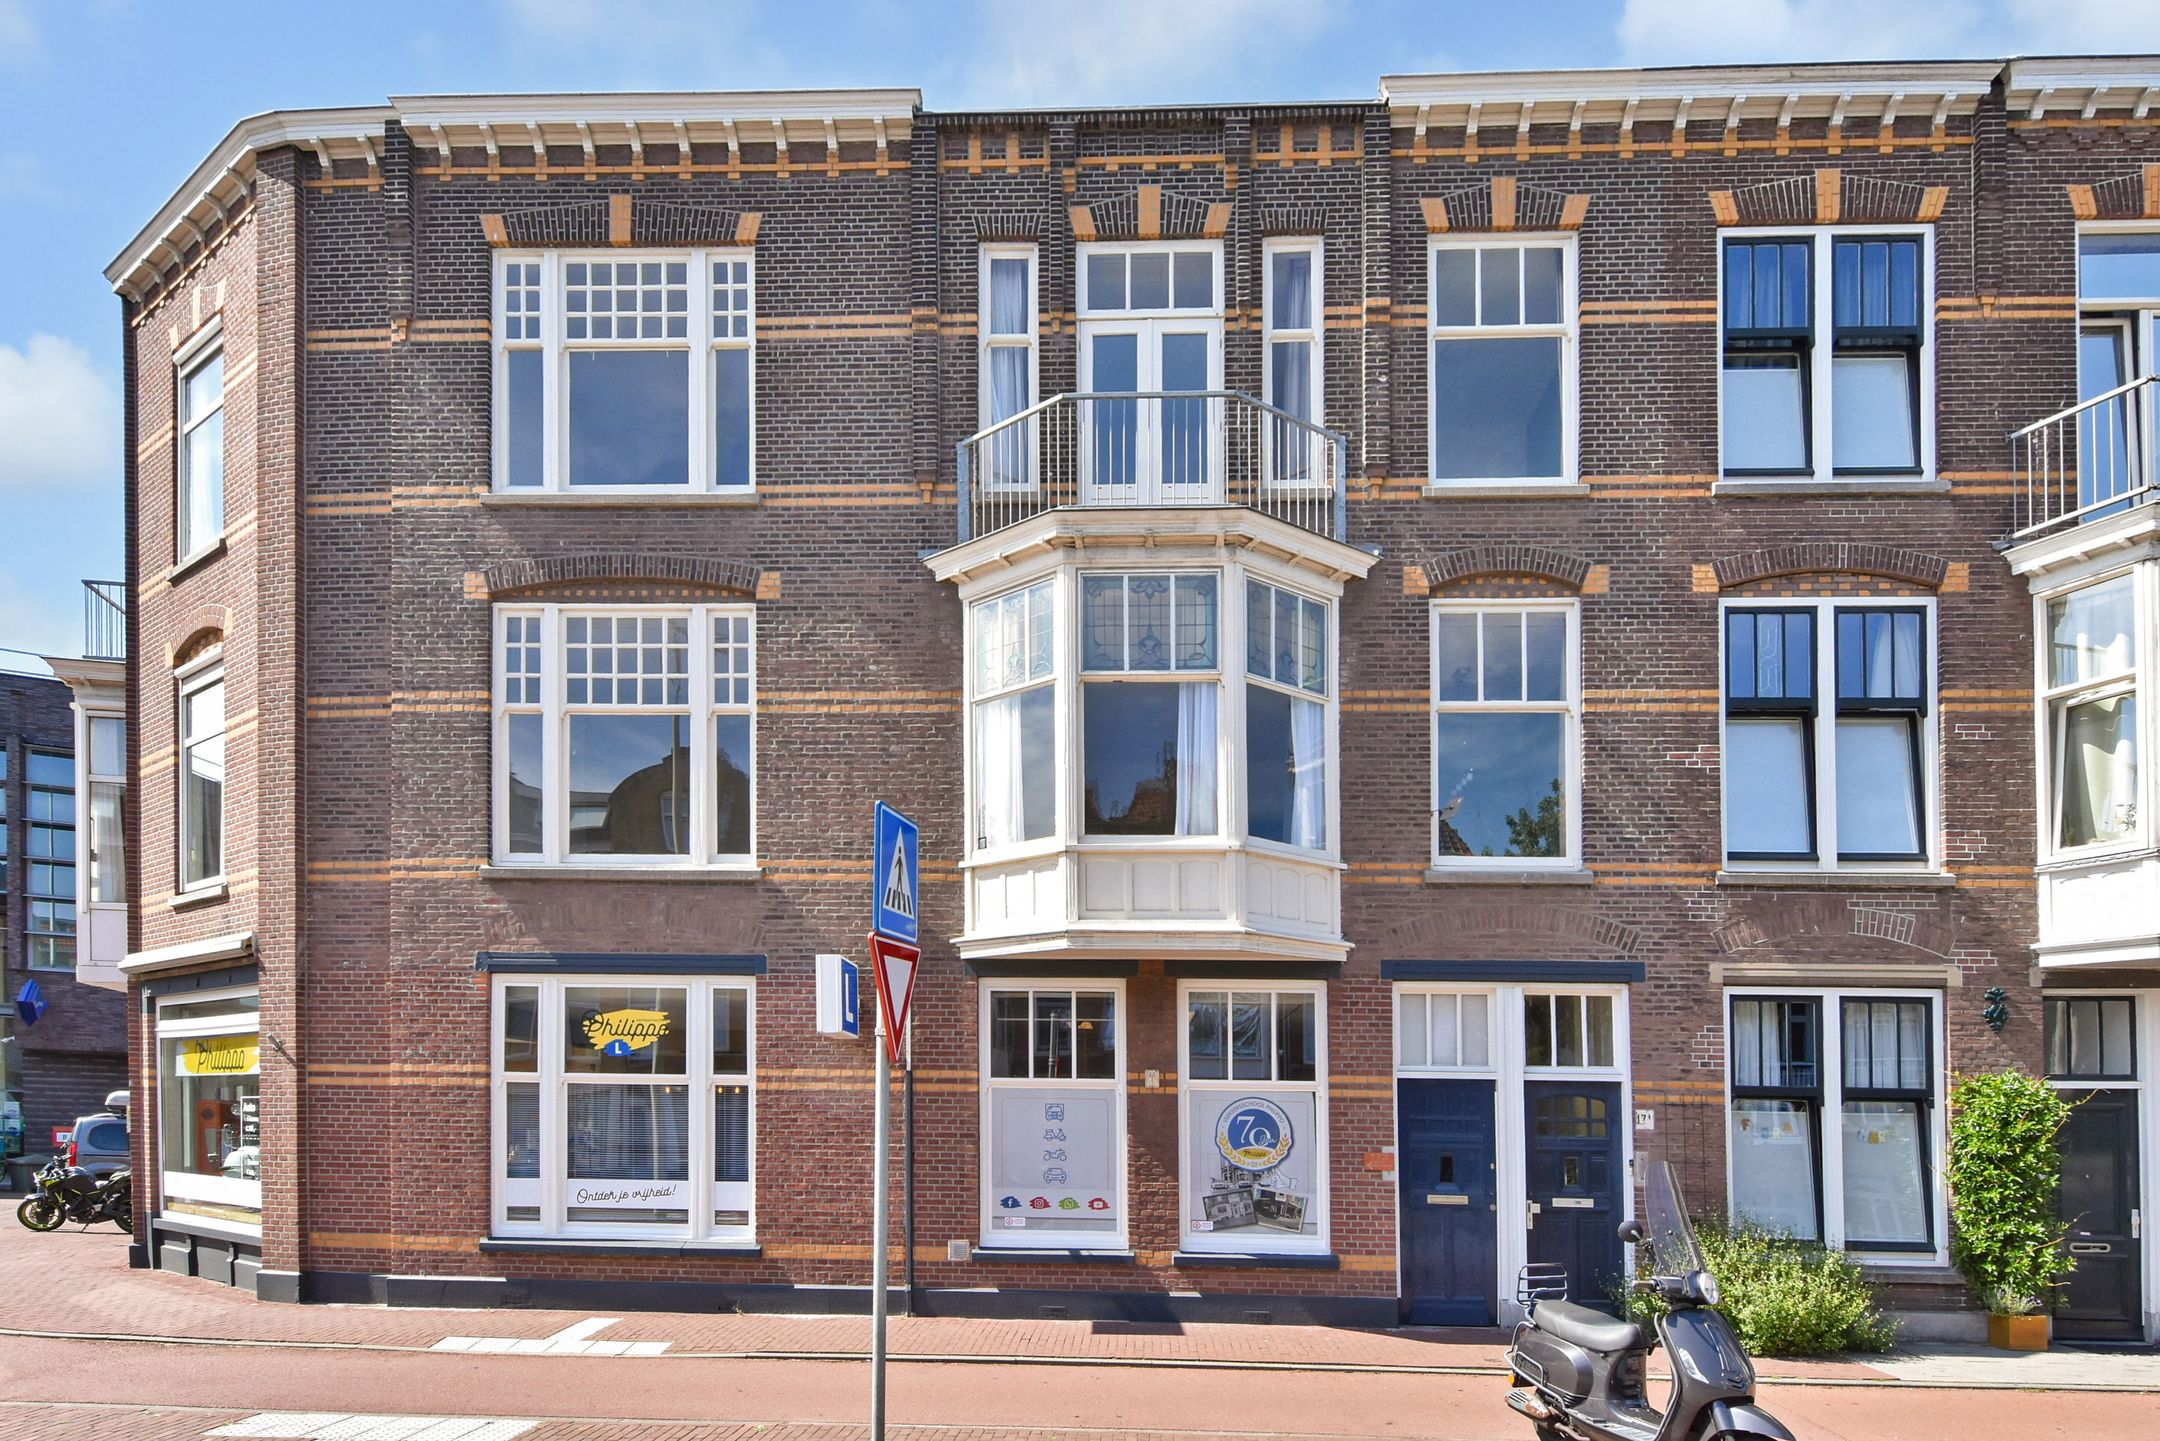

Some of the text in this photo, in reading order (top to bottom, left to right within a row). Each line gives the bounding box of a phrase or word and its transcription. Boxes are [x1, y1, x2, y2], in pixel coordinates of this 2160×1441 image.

[845, 972, 854, 1024] L
[582, 1009, 669, 1042] Philippo
[614, 1042, 622, 1054] L
[1236, 1115, 1271, 1147] 70
[615, 1190, 630, 1203] je
